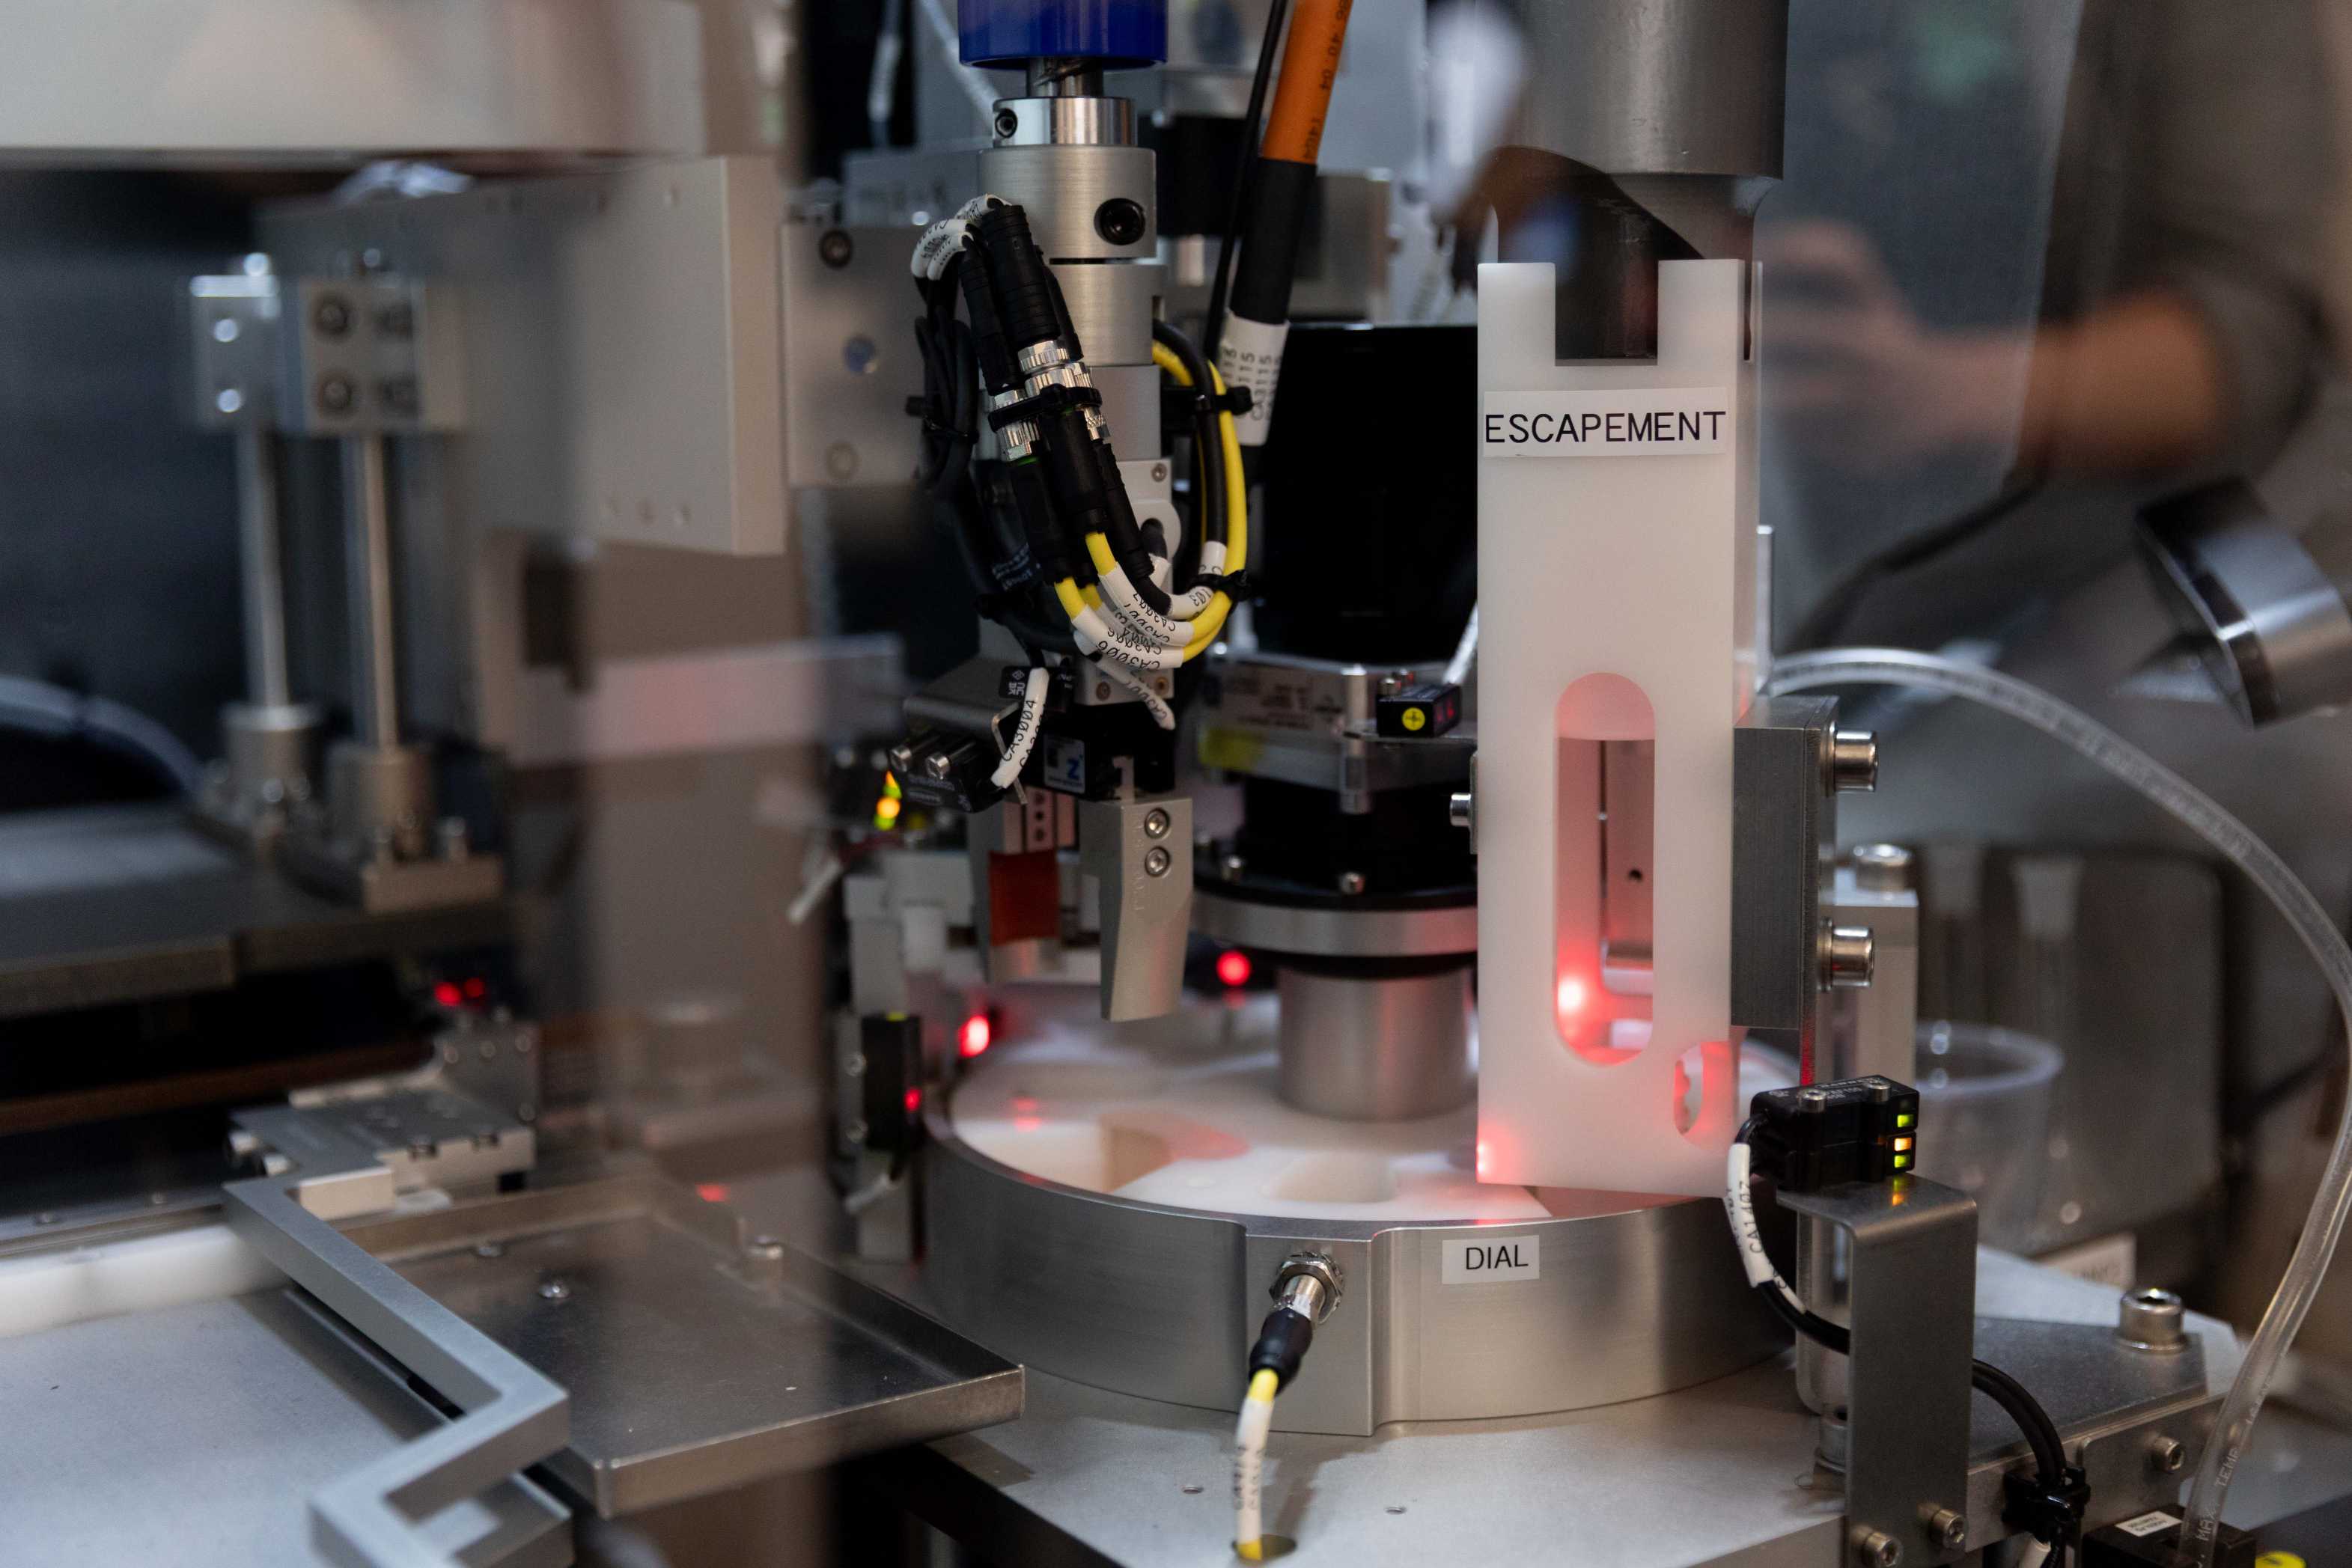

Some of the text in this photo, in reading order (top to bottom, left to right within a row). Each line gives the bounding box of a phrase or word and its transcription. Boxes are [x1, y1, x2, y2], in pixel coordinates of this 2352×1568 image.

[1484, 411, 1726, 444] ESCAPEMENT
[1001, 699, 1038, 762] CA3004
[1466, 1244, 1529, 1270] DIAL
